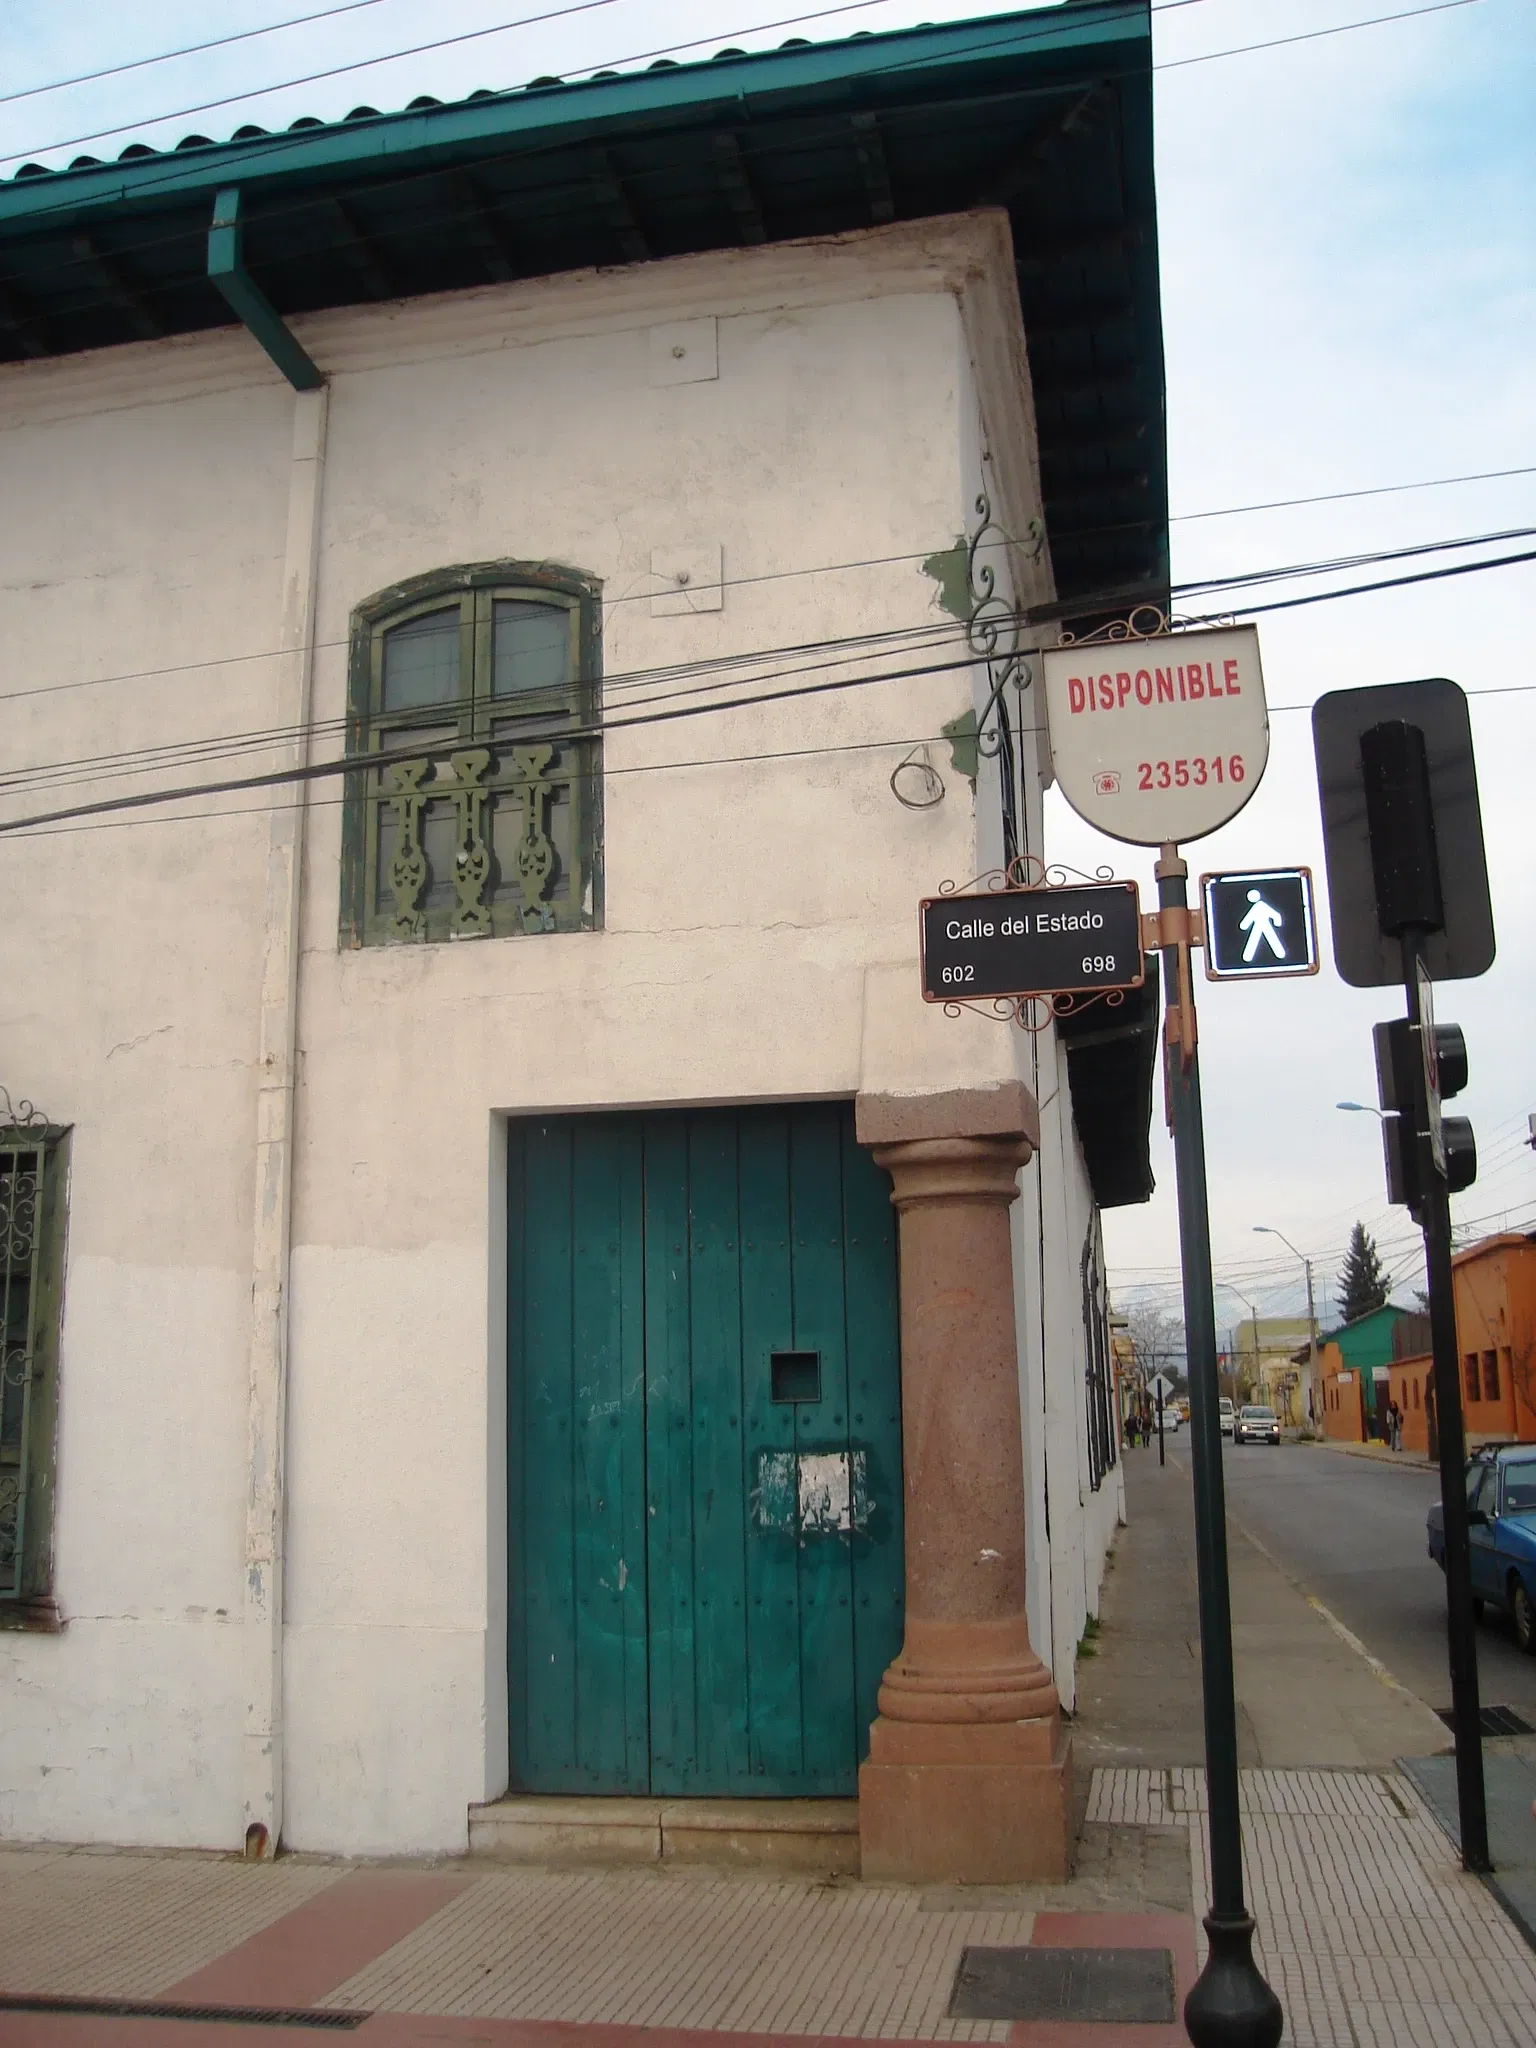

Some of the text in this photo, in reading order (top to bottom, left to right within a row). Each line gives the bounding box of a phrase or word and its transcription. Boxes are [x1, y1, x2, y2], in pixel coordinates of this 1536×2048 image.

[1068, 659, 1241, 714] DISPONIBLE
[1137, 754, 1245, 791] 235316
[946, 910, 1104, 940] Calle del Estado
[941, 955, 1116, 984] 602 698
